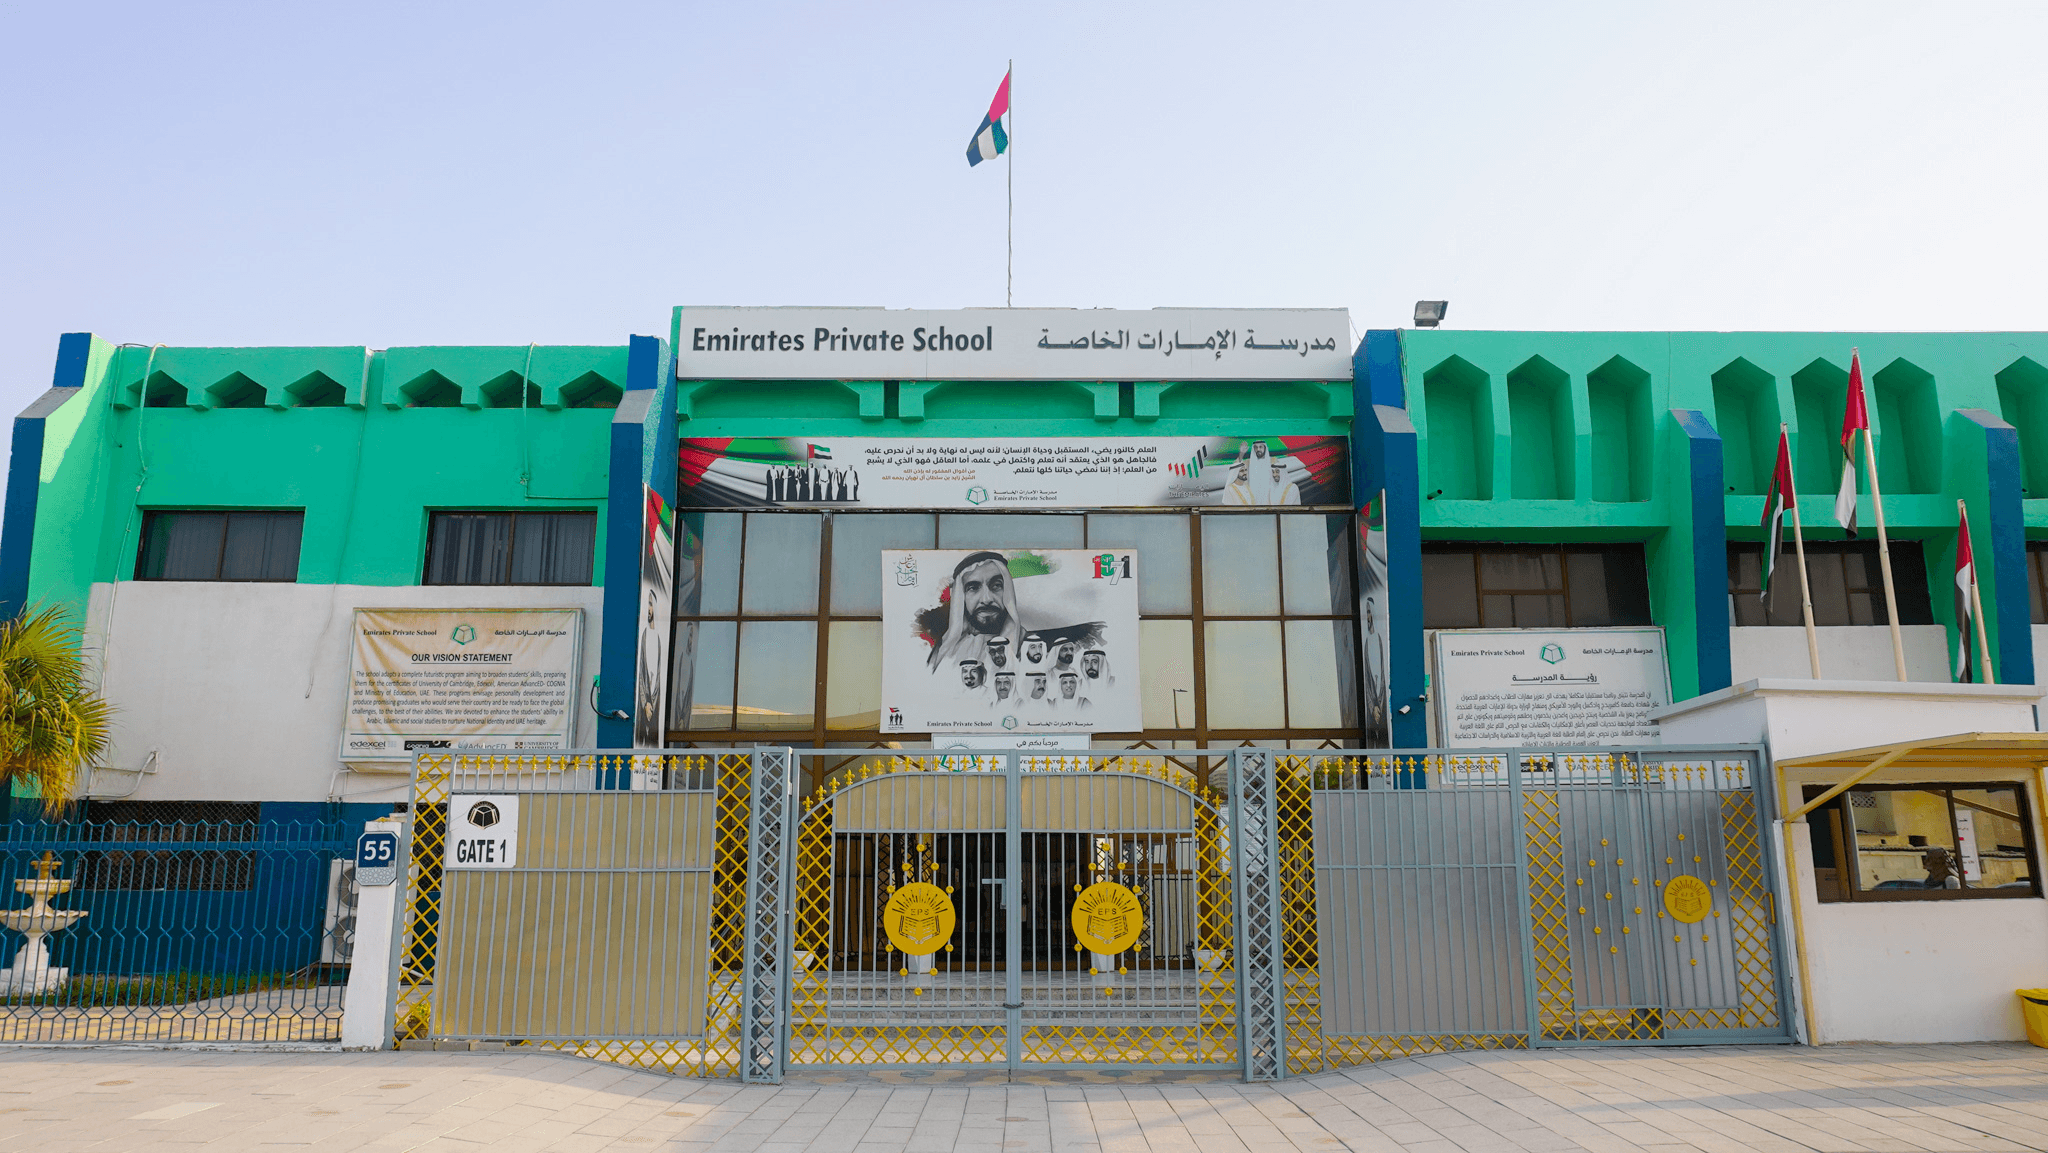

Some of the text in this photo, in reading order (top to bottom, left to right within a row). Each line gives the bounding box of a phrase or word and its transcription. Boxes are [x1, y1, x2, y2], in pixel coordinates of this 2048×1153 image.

[692, 326, 992, 351] Emirates Private School
[1038, 328, 1336, 361] مدرسة الإمارات الخاصة
[884, 447, 904, 455] نحرص
[906, 445, 914, 455] أن
[939, 447, 957, 455] نهاية
[969, 447, 984, 455] ليس
[866, 456, 884, 465] يشبع
[895, 457, 912, 466] الذي
[915, 457, 930, 465] فهو
[959, 455, 969, 463] أما
[994, 457, 1006, 466] في
[1057, 455, 1066, 463] أنه
[1093, 457, 1110, 465] الذي
[1126, 456, 1156, 464] فالجاهل
[1037, 466, 1052, 474] كلها
[1055, 466, 1072, 474] حياتنا
[1075, 466, 1098, 476] نمضي
[1113, 466, 1120, 474] إذ
[1146, 466, 1157, 474] من
[402, 671, 423, 679] complete
[466, 671, 481, 679] aiming
[544, 671, 566, 679] preparing
[1512, 674, 1557, 683] المدرسة
[1017, 740, 1026, 748] في
[364, 840, 391, 861] 55
[457, 839, 506, 863] GATE 1
[1097, 907, 1117, 916] EPS
